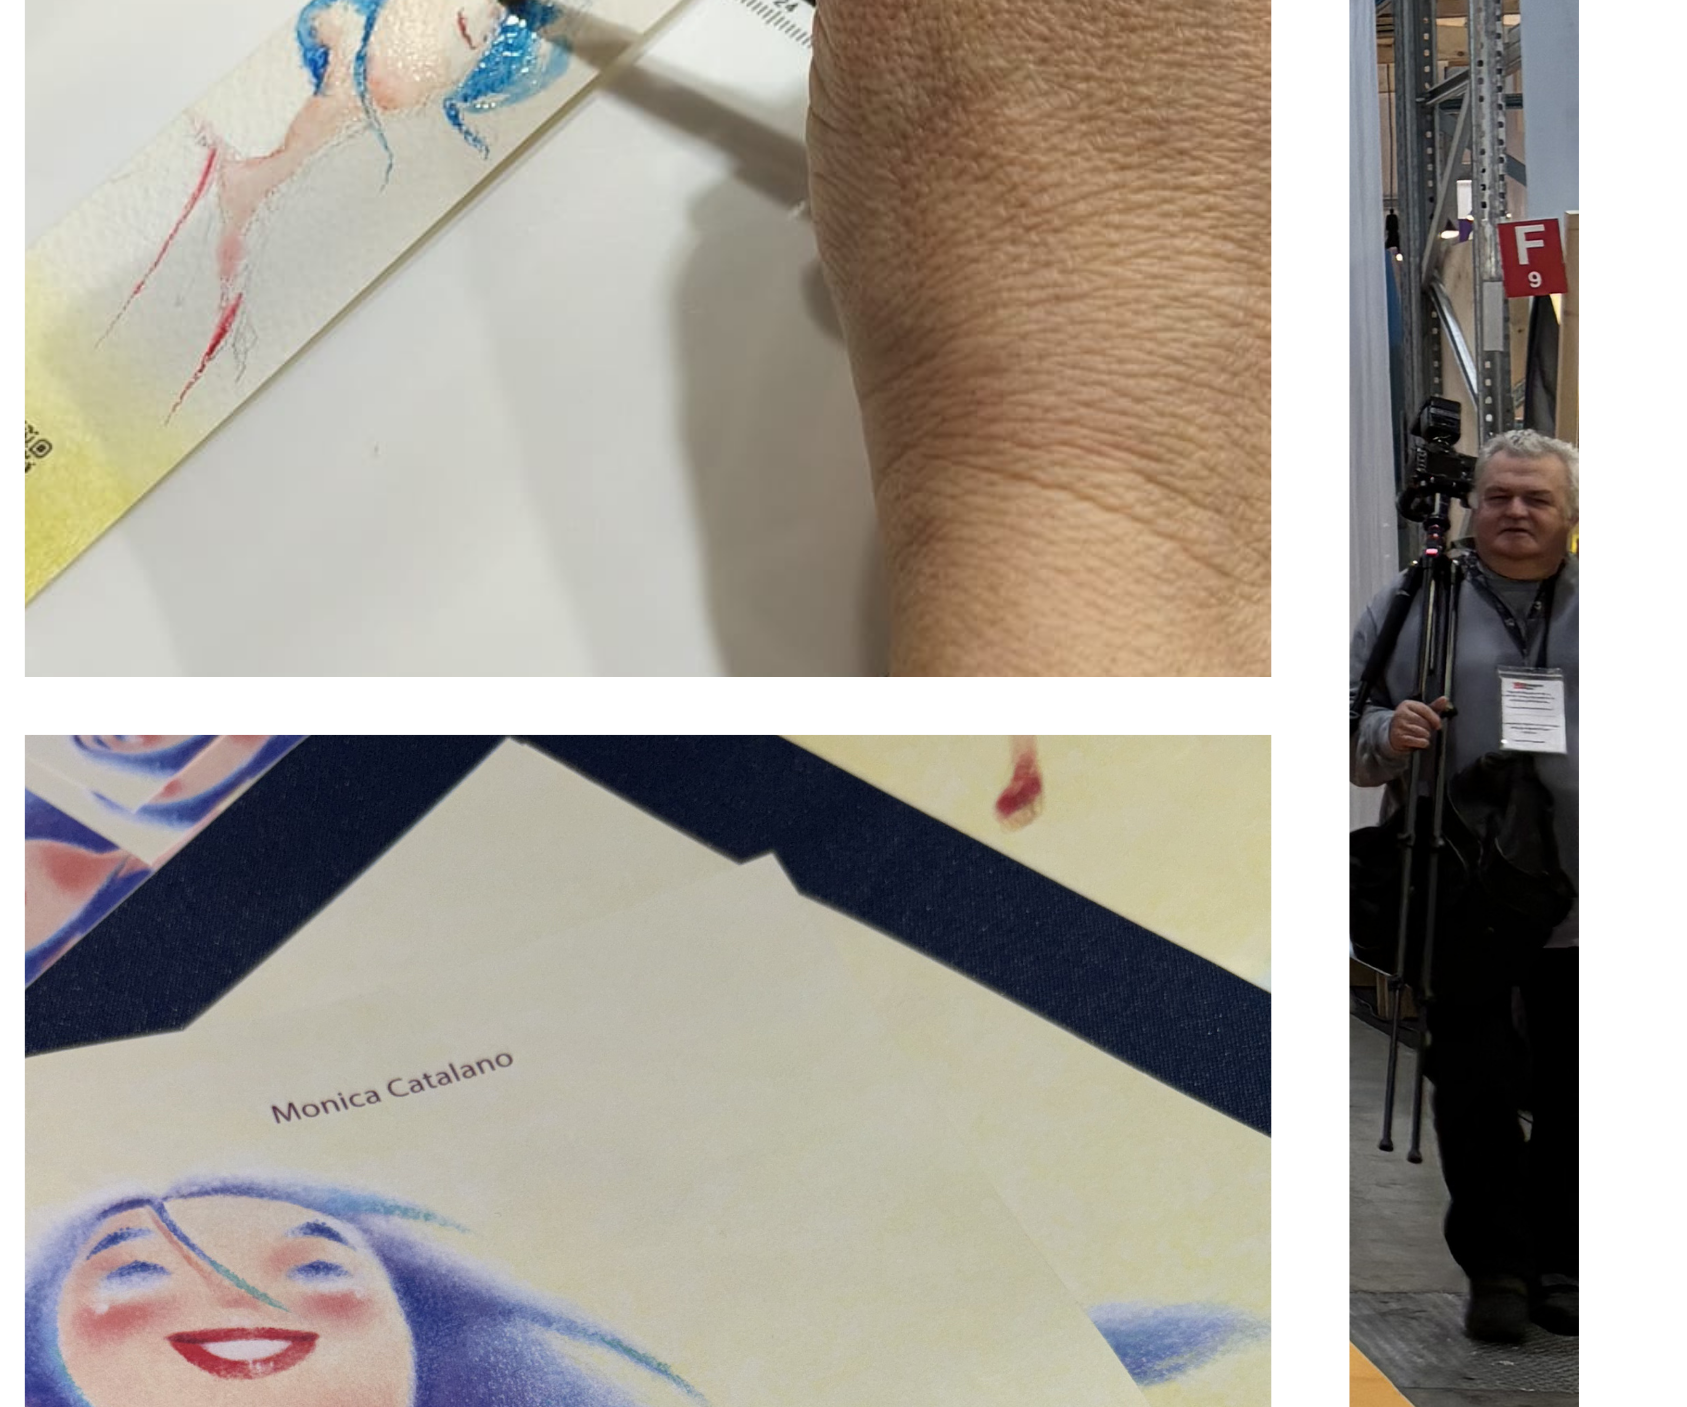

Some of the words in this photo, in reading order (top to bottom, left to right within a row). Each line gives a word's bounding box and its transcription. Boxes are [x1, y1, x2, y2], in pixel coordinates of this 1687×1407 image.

[1515, 224, 1545, 265] F
[1528, 271, 1542, 288] 9
[270, 1089, 382, 1125] Monica
[386, 1052, 515, 1098] Catalano
